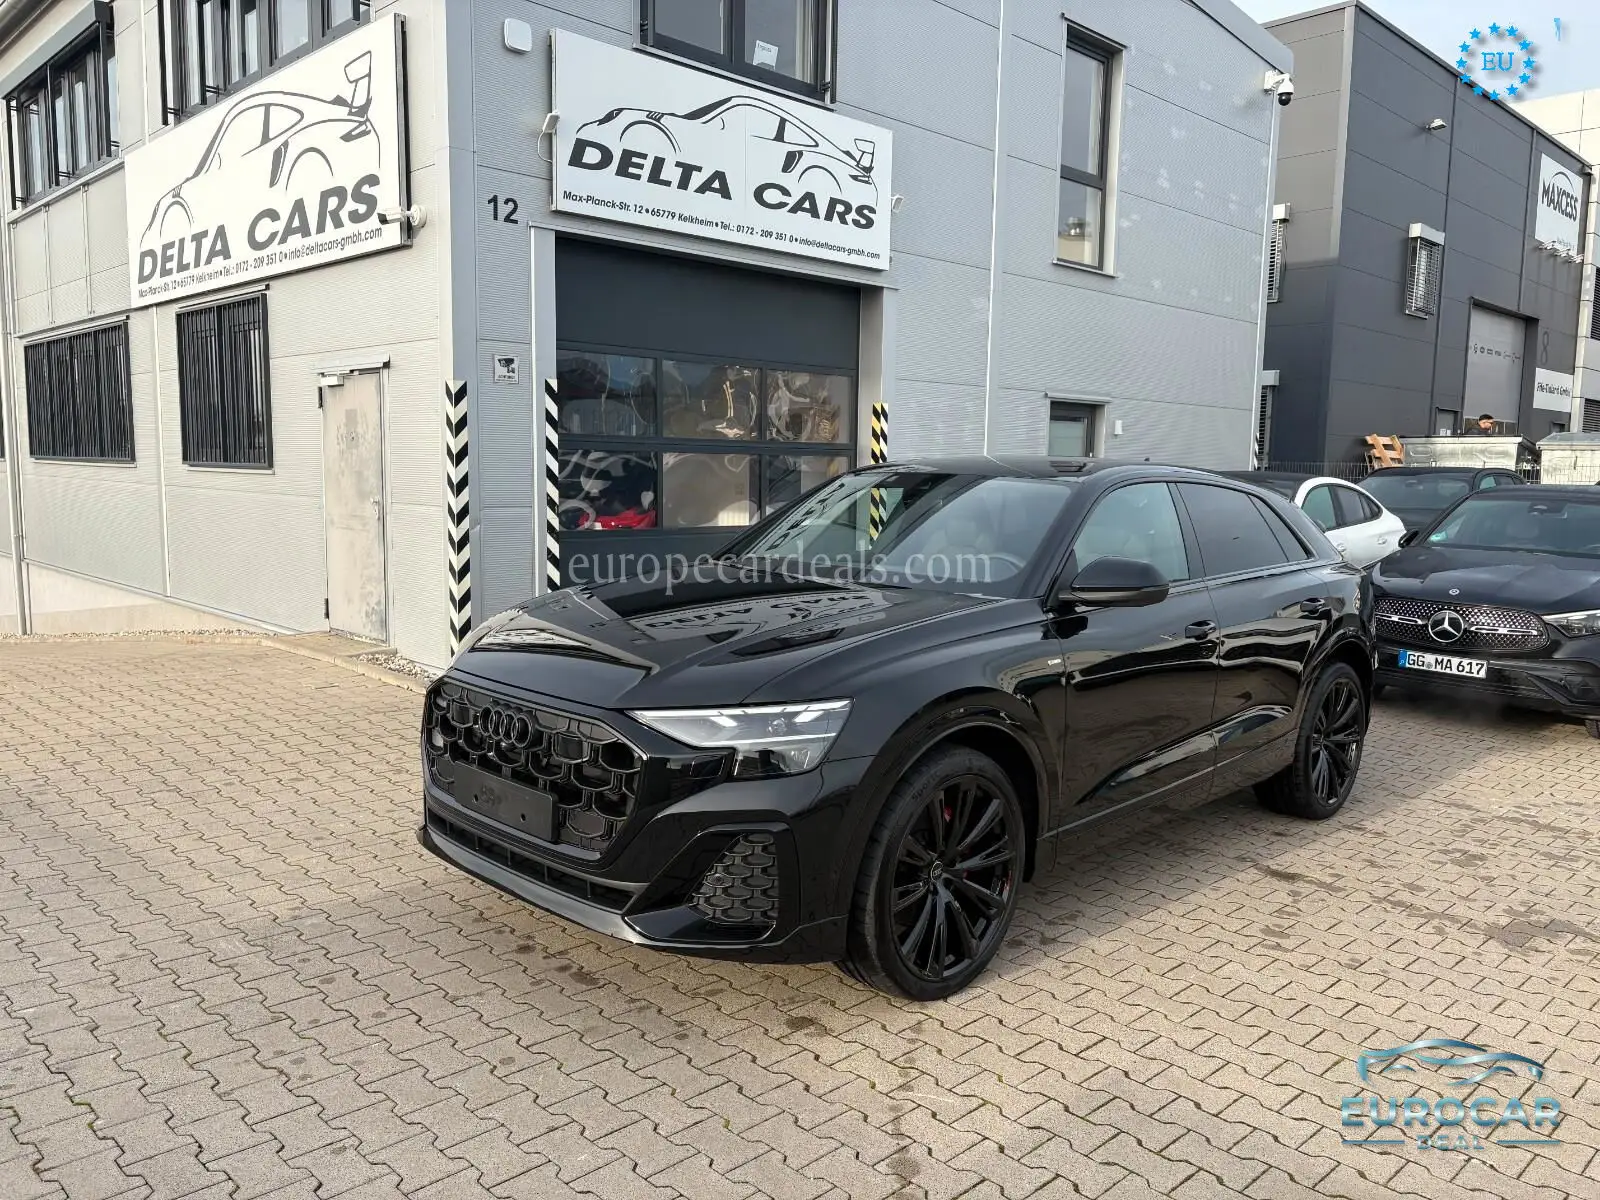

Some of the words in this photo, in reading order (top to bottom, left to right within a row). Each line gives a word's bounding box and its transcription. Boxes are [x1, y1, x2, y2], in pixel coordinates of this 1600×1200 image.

[567, 137, 733, 201] DELTA
[753, 182, 877, 230] CARS
[1541, 180, 1579, 222] MAXCESS
[487, 194, 519, 224] 12
[562, 190, 631, 212] Max-Planck-Str.
[633, 203, 644, 214] 12
[650, 207, 676, 220] 65779
[678, 212, 714, 228] Kelkheim
[736, 223, 755, 235] 0172
[760, 229, 774, 239] 209
[775, 232, 787, 242] 351
[788, 234, 794, 243] 0
[798, 236, 881, 260] info@deltacars-gmbh.com
[137, 223, 232, 285] DELTA
[247, 173, 381, 252] CARS
[235, 260, 249, 274] 0172
[253, 255, 265, 269] 209
[266, 252, 277, 266] 351
[1541, 330, 1550, 365] 8
[1407, 653, 1426, 668] GG
[1434, 657, 1454, 671] MA
[1456, 660, 1485, 675] 617
